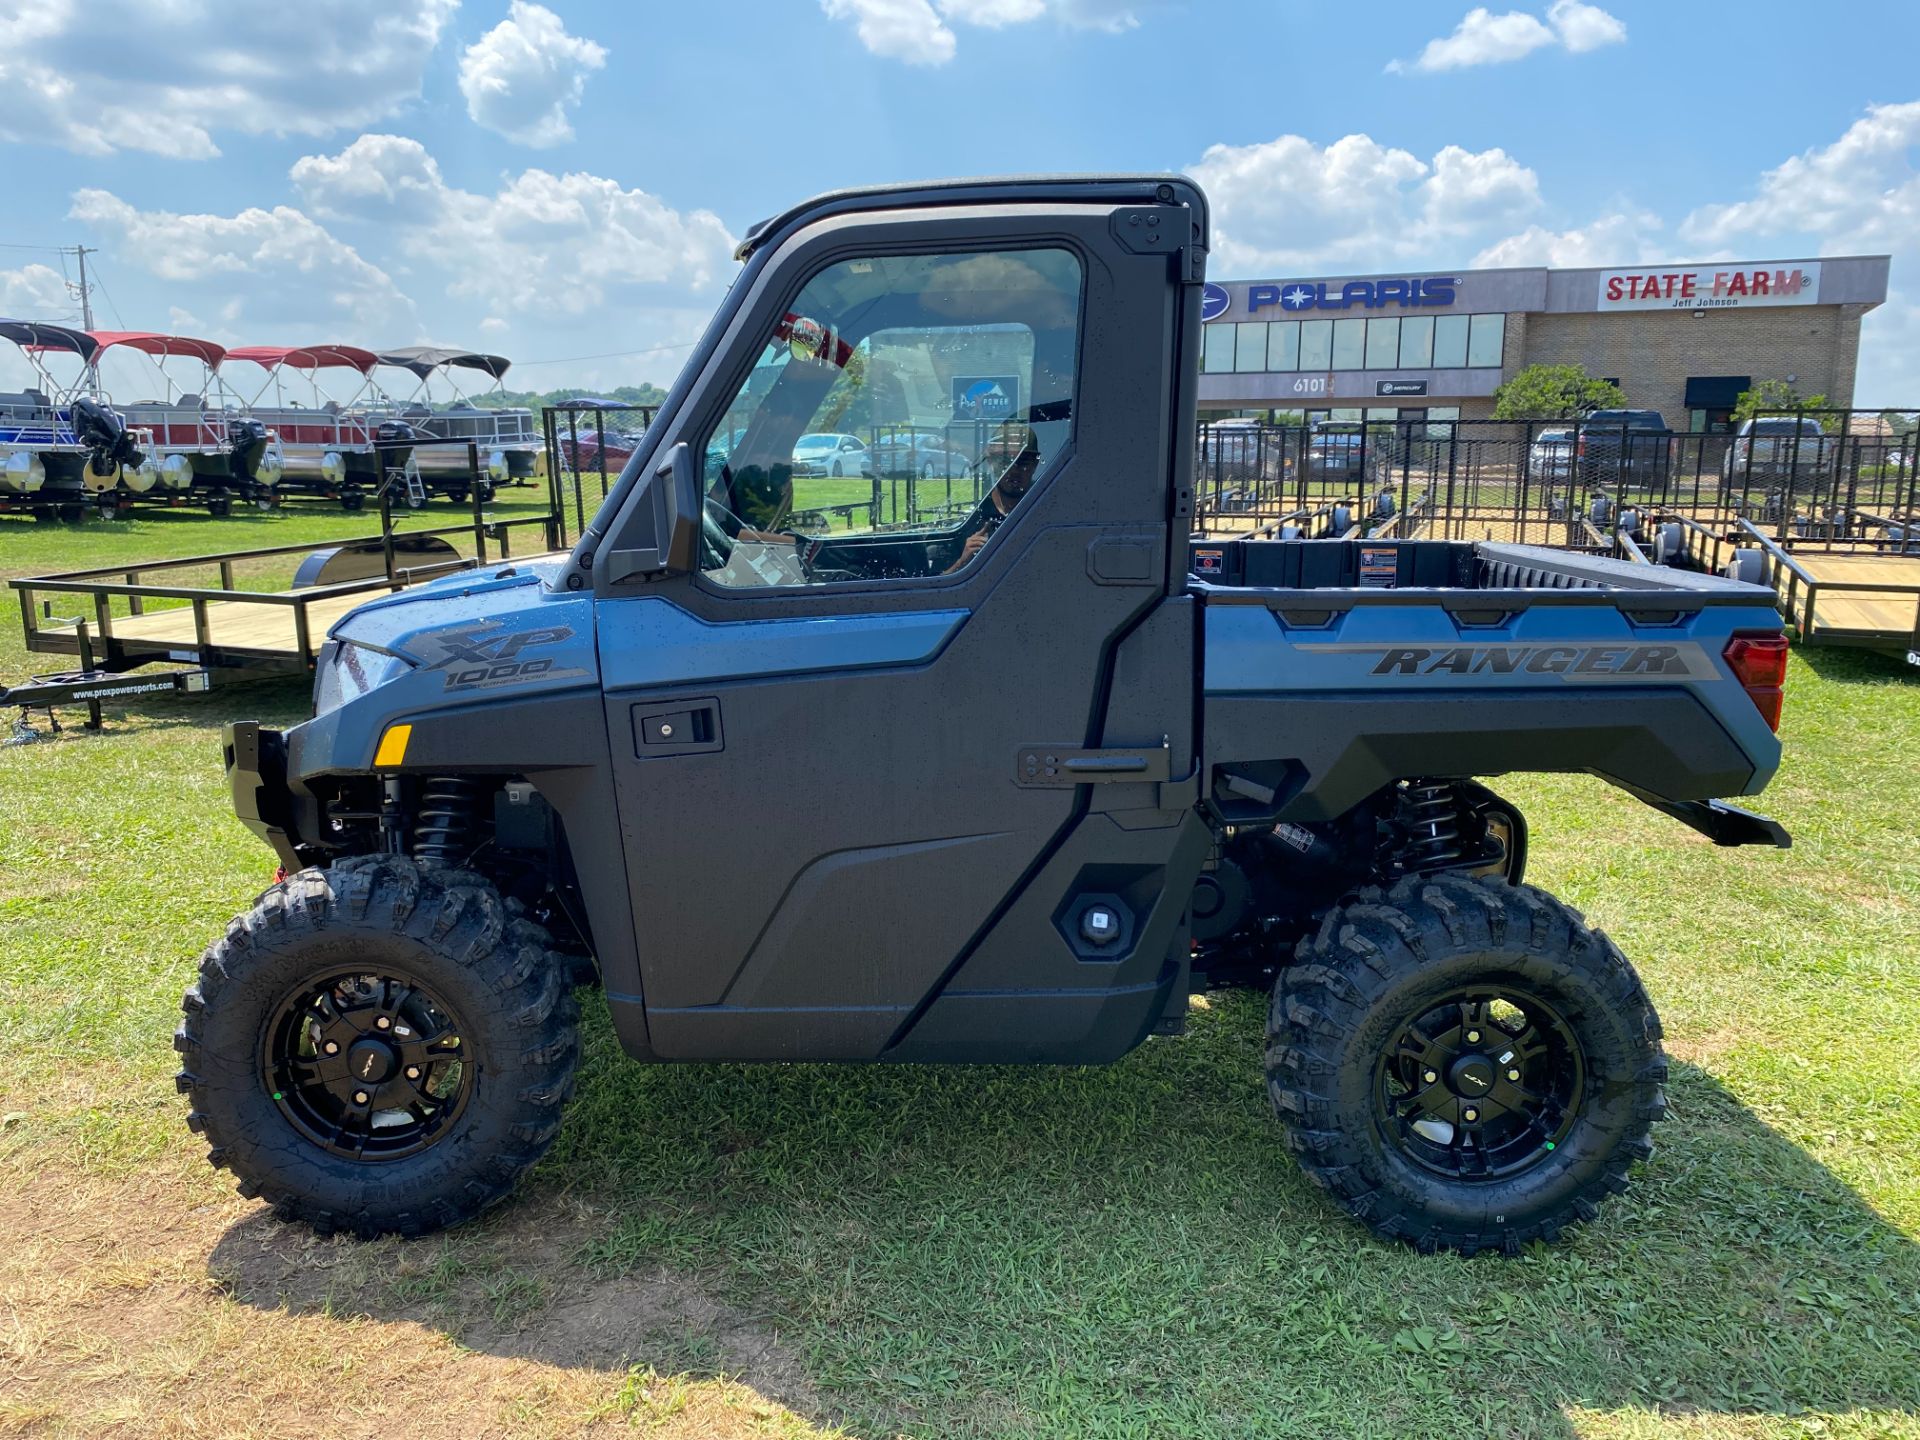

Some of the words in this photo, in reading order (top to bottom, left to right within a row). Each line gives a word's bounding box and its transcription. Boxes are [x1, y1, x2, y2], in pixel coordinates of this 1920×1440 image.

[1248, 277, 1457, 313] POLARIS
[1606, 273, 1698, 300] STATE
[1712, 269, 1803, 297] FARM
[1672, 299, 1692, 308] Jeff
[1696, 298, 1739, 307] Johnson
[422, 625, 577, 672] XP
[1367, 645, 1691, 676] RANGER
[445, 658, 554, 688] 1000
[73, 681, 175, 700] www.proxpowersports.com
